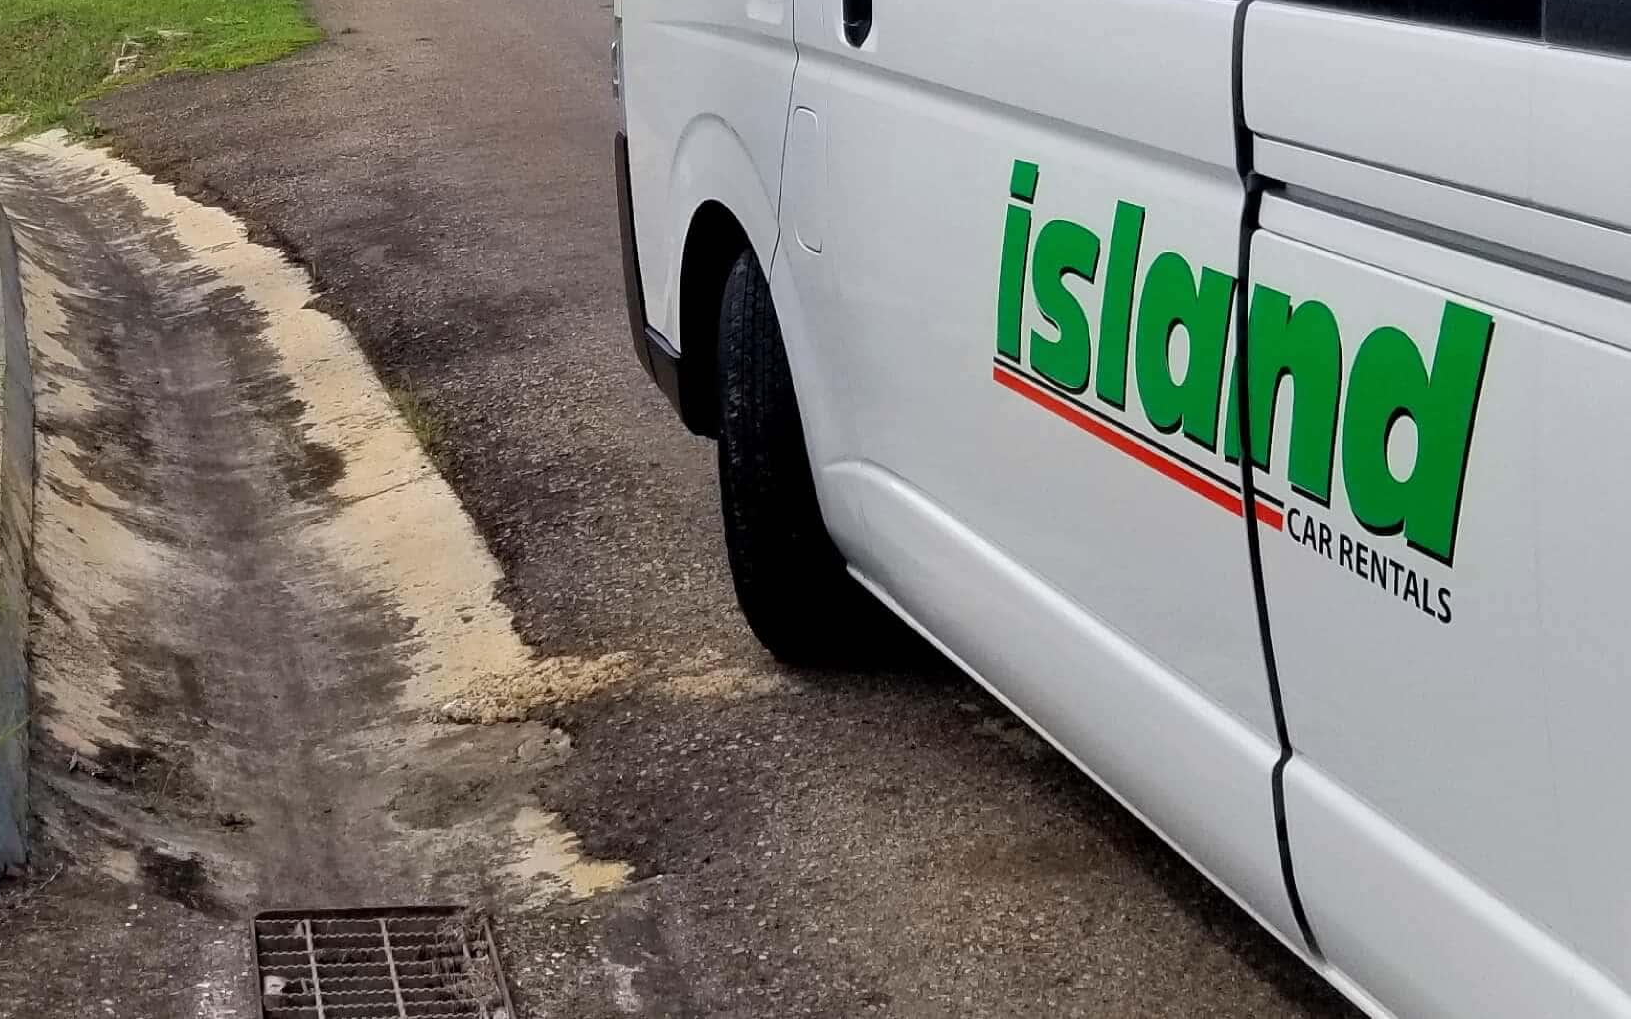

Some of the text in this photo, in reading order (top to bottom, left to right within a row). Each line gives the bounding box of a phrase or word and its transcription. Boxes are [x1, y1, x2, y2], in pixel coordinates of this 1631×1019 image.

[996, 158, 1495, 568] island
[1286, 507, 1453, 624] CAR RENTALS
